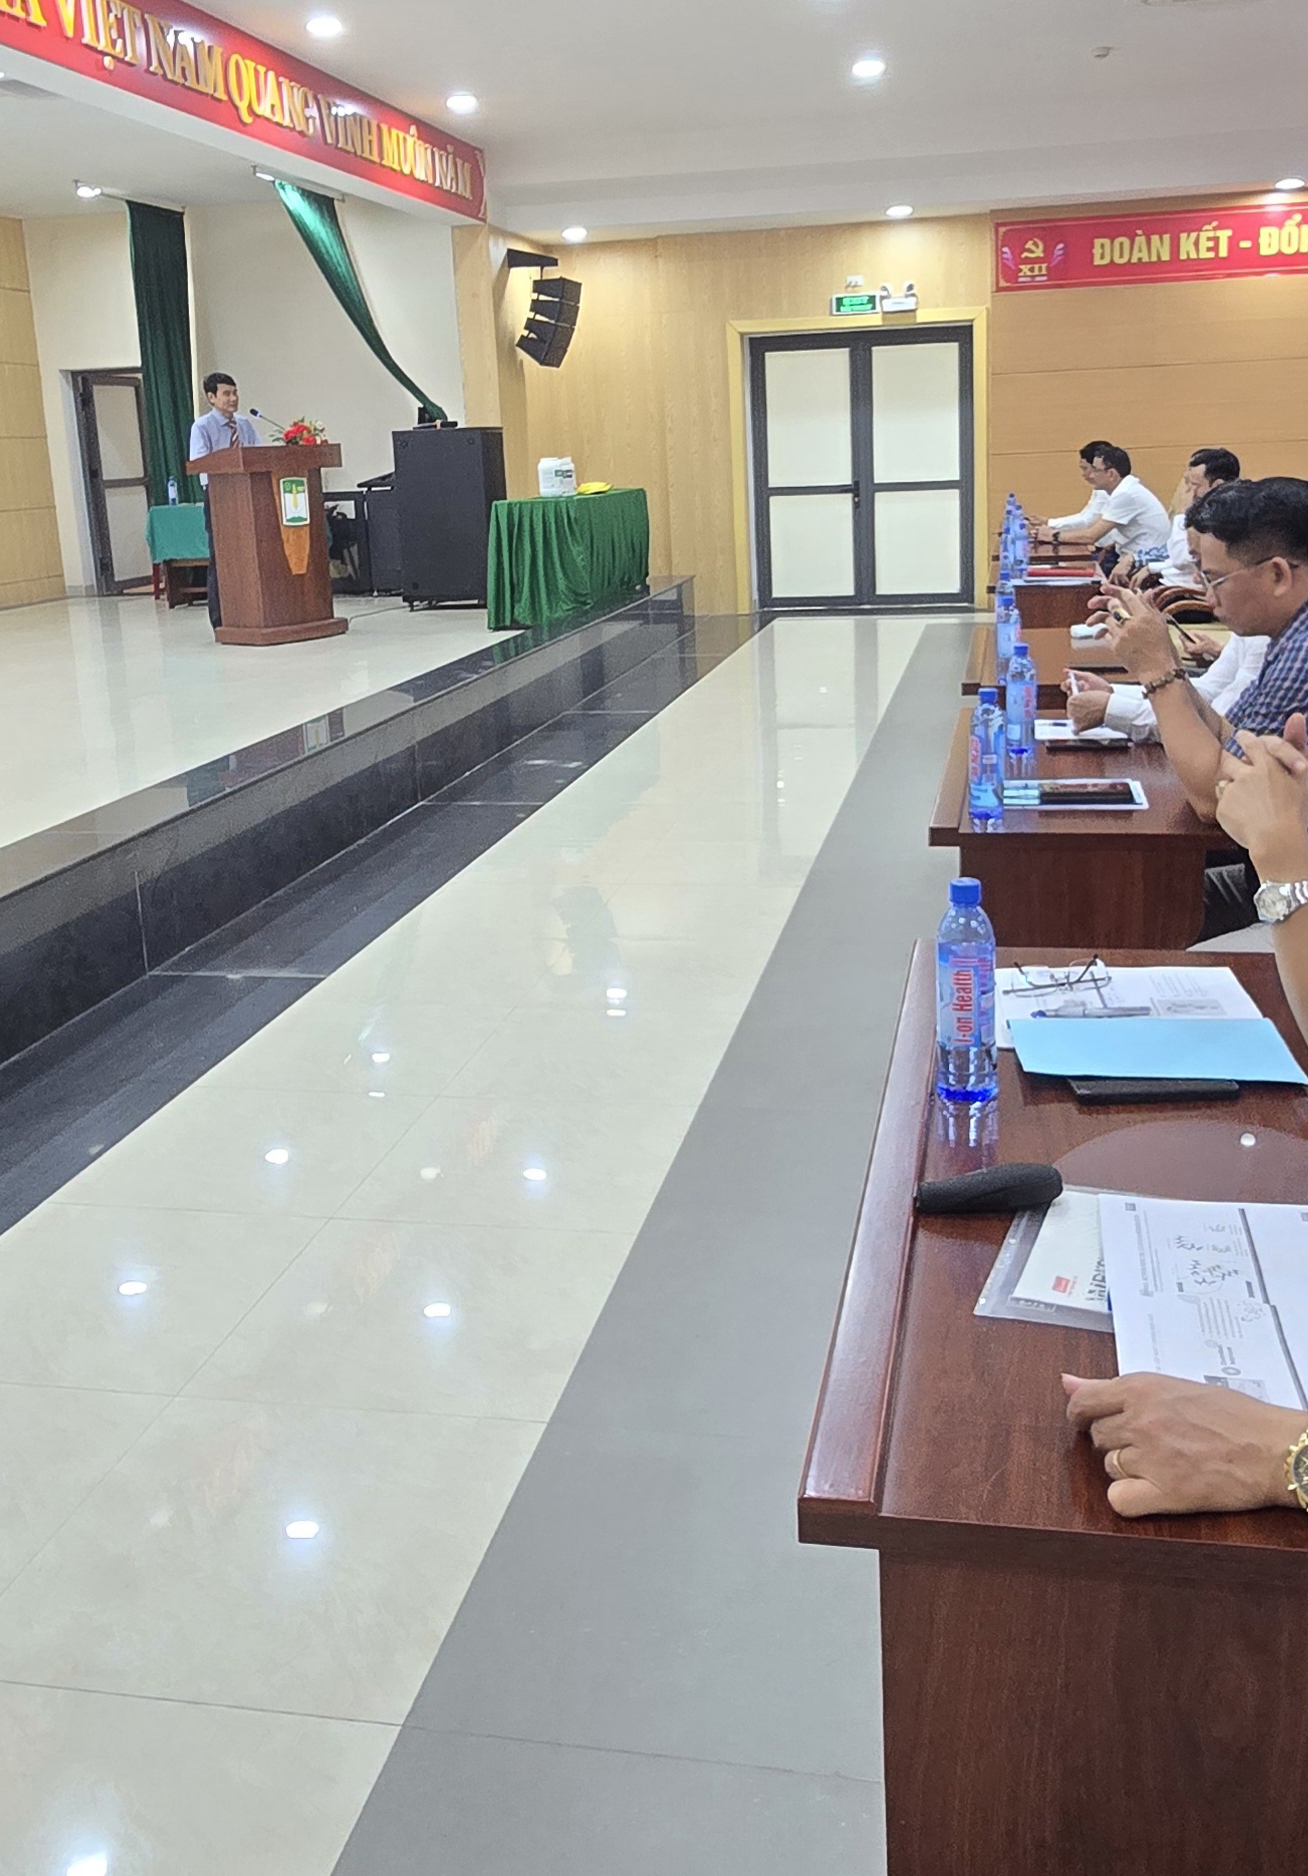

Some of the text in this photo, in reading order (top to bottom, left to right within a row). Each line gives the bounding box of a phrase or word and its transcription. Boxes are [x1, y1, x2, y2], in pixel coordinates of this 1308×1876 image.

[145, 13, 228, 101] NAM
[228, 53, 315, 138] QUANG
[380, 124, 433, 184] MUÔN
[432, 144, 474, 200] NĂM
[1093, 230, 1171, 266] ĐOÀN
[1179, 221, 1233, 261] KẾT
[1018, 263, 1048, 277] XII
[952, 969, 974, 1013] Health
